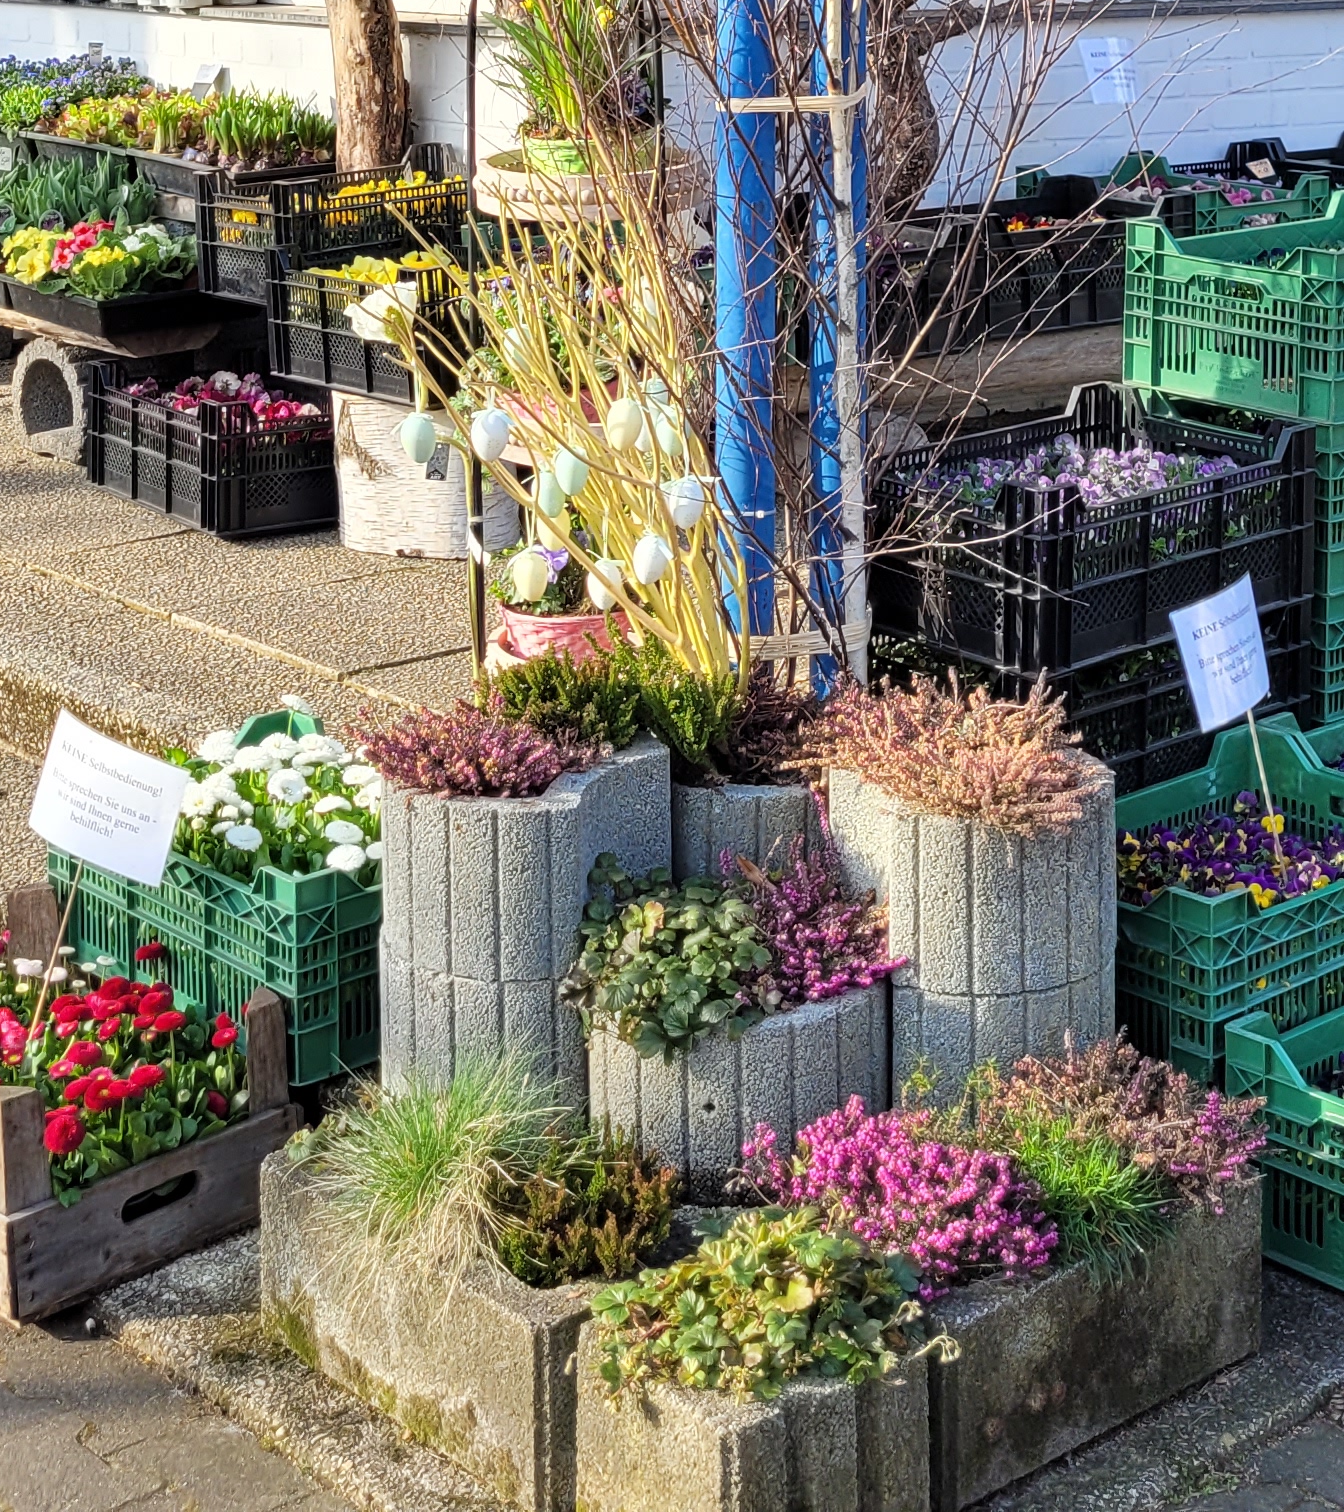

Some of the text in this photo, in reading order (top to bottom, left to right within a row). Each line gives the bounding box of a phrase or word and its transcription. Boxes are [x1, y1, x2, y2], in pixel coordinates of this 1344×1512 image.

[1192, 621, 1219, 640] KEINE
[62, 740, 164, 798] KEINE Selbstbedienung!
[58, 789, 140, 834] wir sind Ihnen gerne
[69, 780, 103, 804] sprechen
[104, 796, 120, 810] Sie
[121, 806, 137, 818] uns
[139, 814, 151, 823] an
[70, 810, 114, 839] behilflich!
